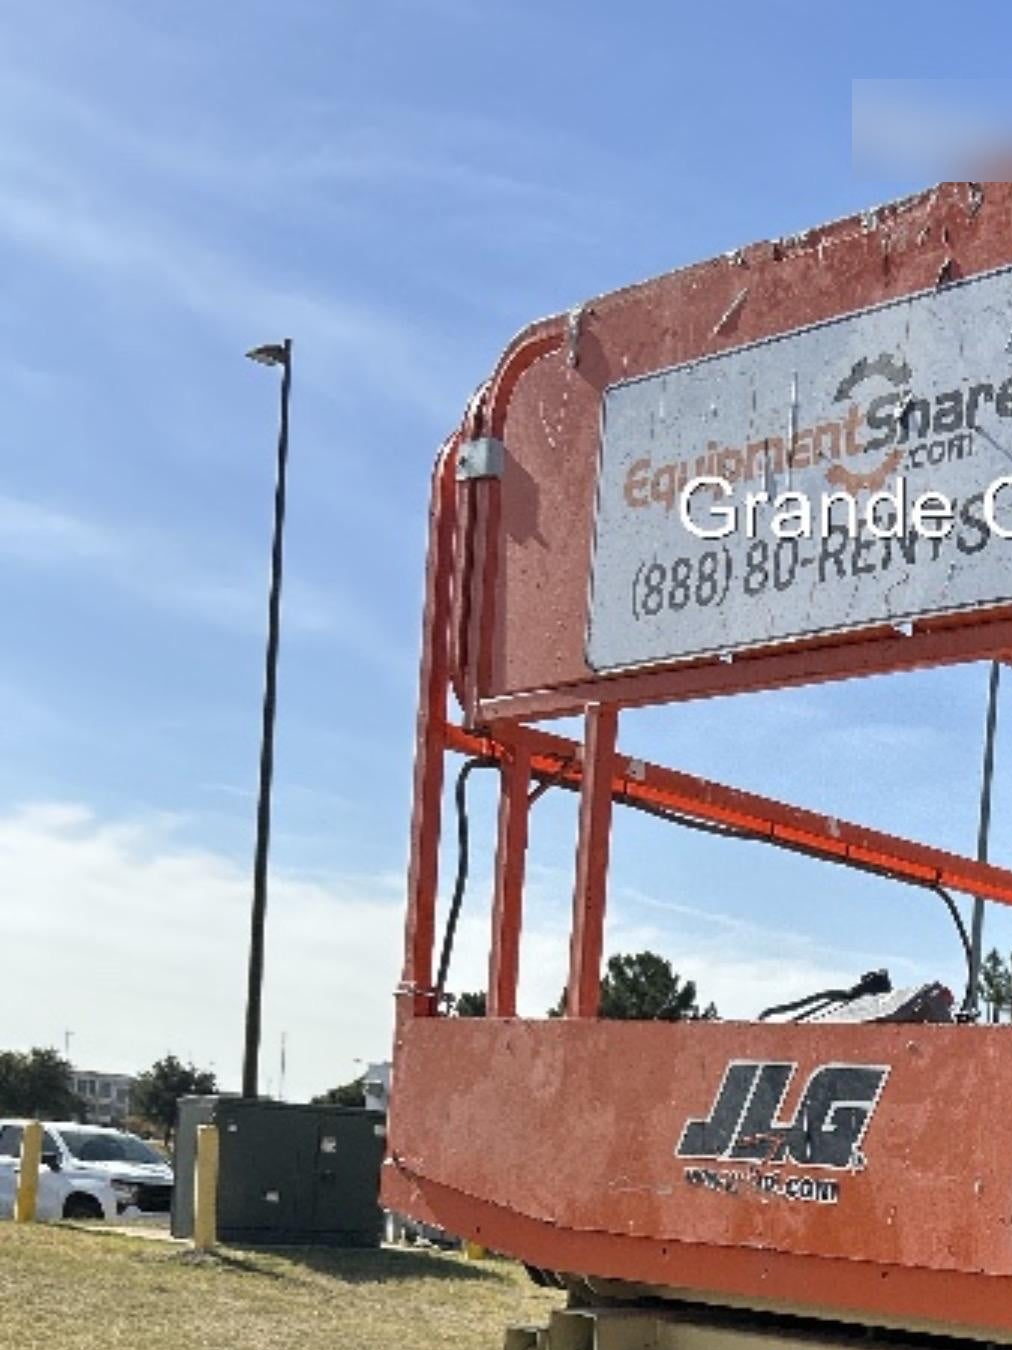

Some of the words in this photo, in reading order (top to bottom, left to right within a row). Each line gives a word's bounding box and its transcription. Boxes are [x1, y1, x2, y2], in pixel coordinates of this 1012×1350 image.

[903, 434, 974, 472] .com
[632, 545, 733, 622] (888)
[676, 1059, 892, 1172] JLG
